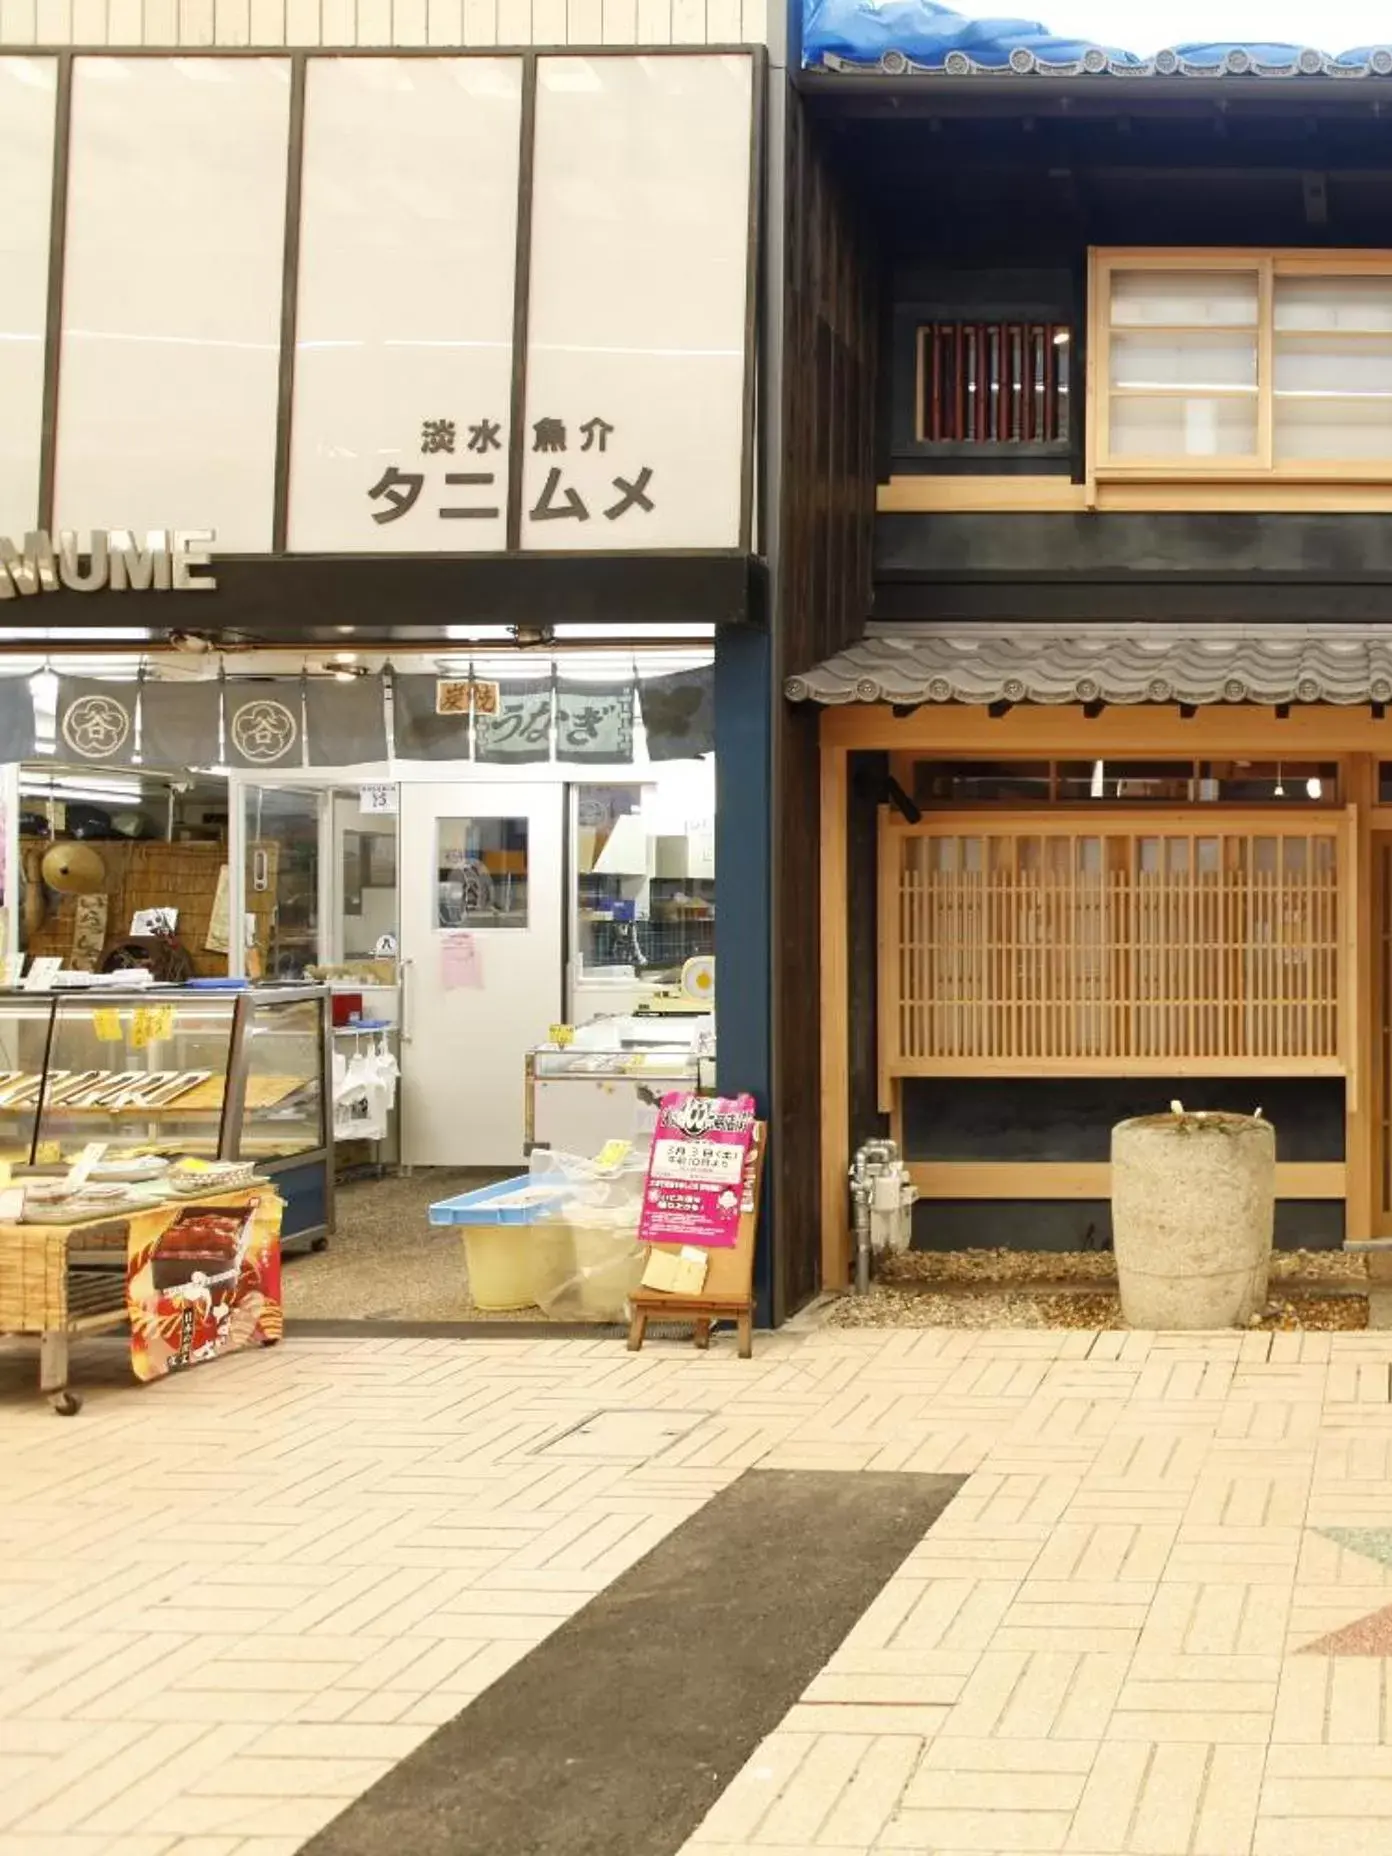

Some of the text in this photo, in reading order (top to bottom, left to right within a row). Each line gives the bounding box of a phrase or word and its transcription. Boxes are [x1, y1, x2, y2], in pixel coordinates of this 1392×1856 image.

[421, 418, 614, 453] 淡水魚介
[367, 466, 655, 525] タニムメ
[492, 700, 615, 746] うなぎ
